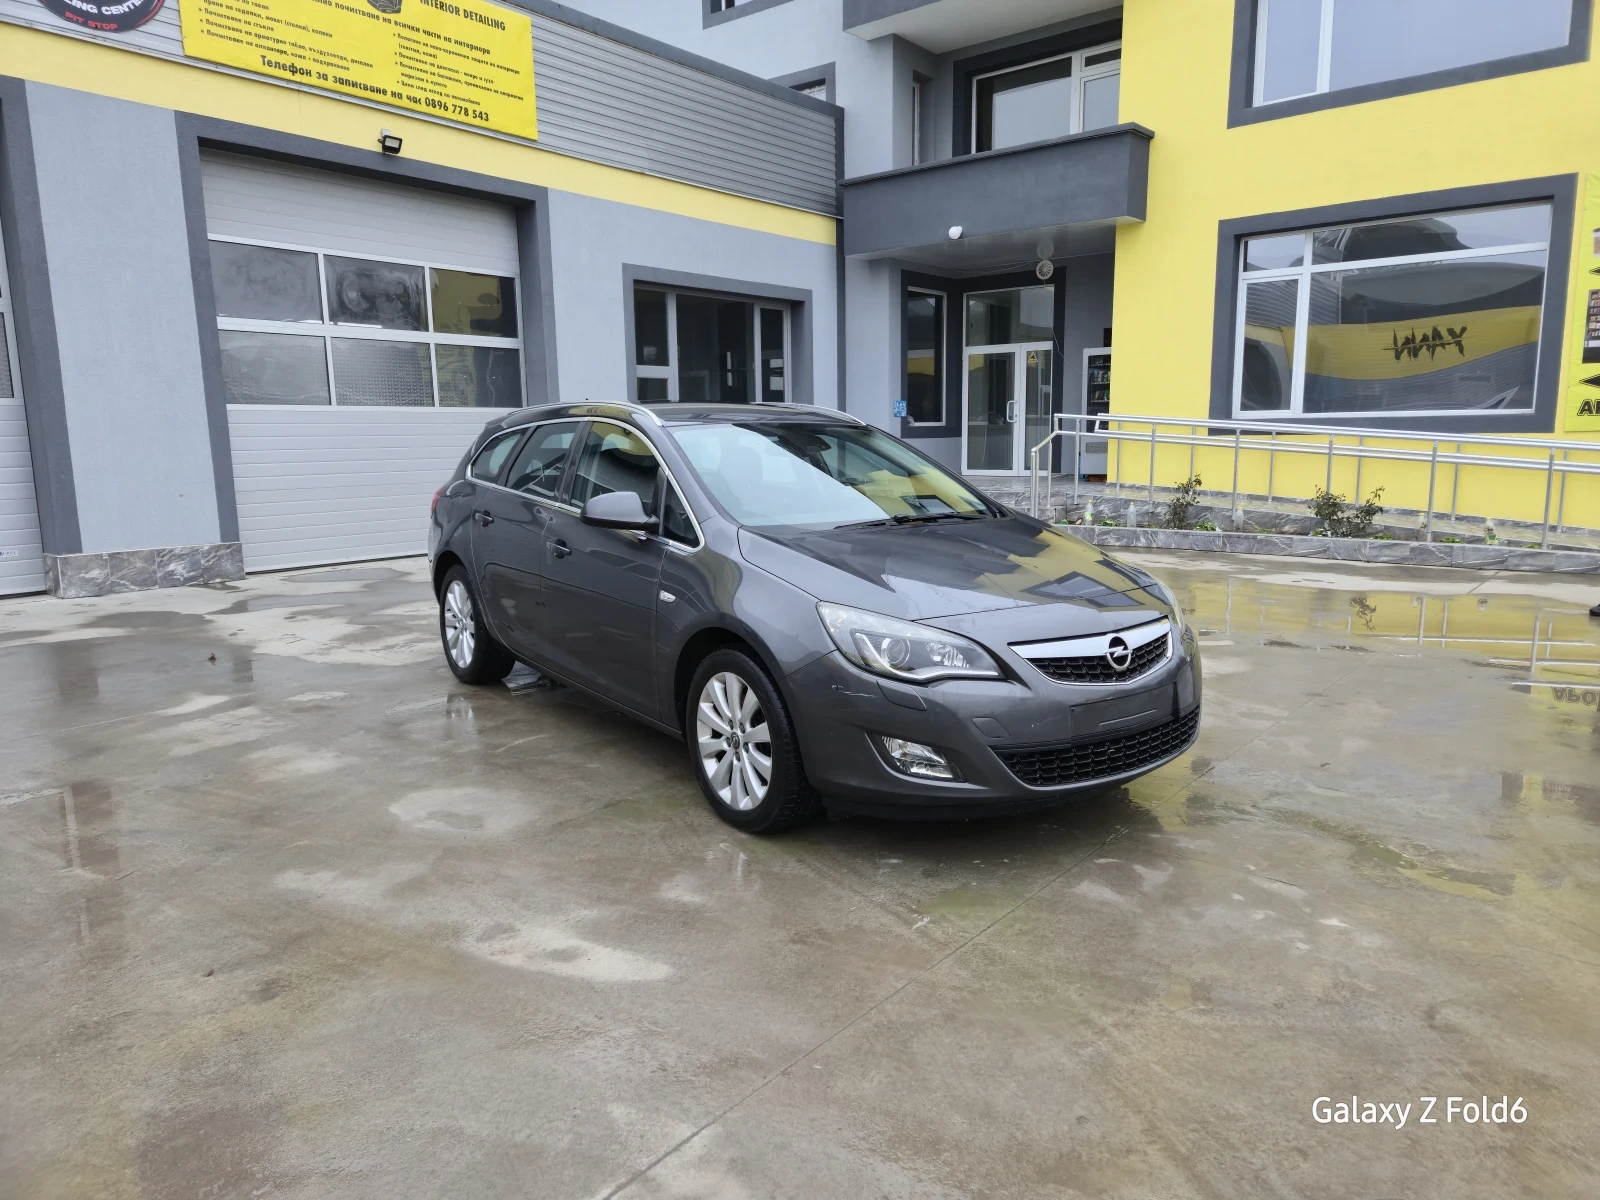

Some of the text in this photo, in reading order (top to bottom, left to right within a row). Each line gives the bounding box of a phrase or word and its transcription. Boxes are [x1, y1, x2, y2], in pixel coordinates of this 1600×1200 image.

[101, 0, 145, 15] CENTE
[204, 8, 242, 23] Почистване
[235, 7, 264, 20] седалки,
[64, 11, 118, 30] PIT STOP
[205, 18, 243, 34] Почистване
[463, 9, 506, 31] DETAILING
[206, 29, 244, 44] Почистване
[335, 2, 380, 21] почистване
[382, 16, 392, 24] на
[394, 20, 420, 33] всички
[422, 29, 441, 40] части
[454, 39, 491, 55] интериора
[260, 55, 489, 122] Телефон за записване на час 0896 778 543
